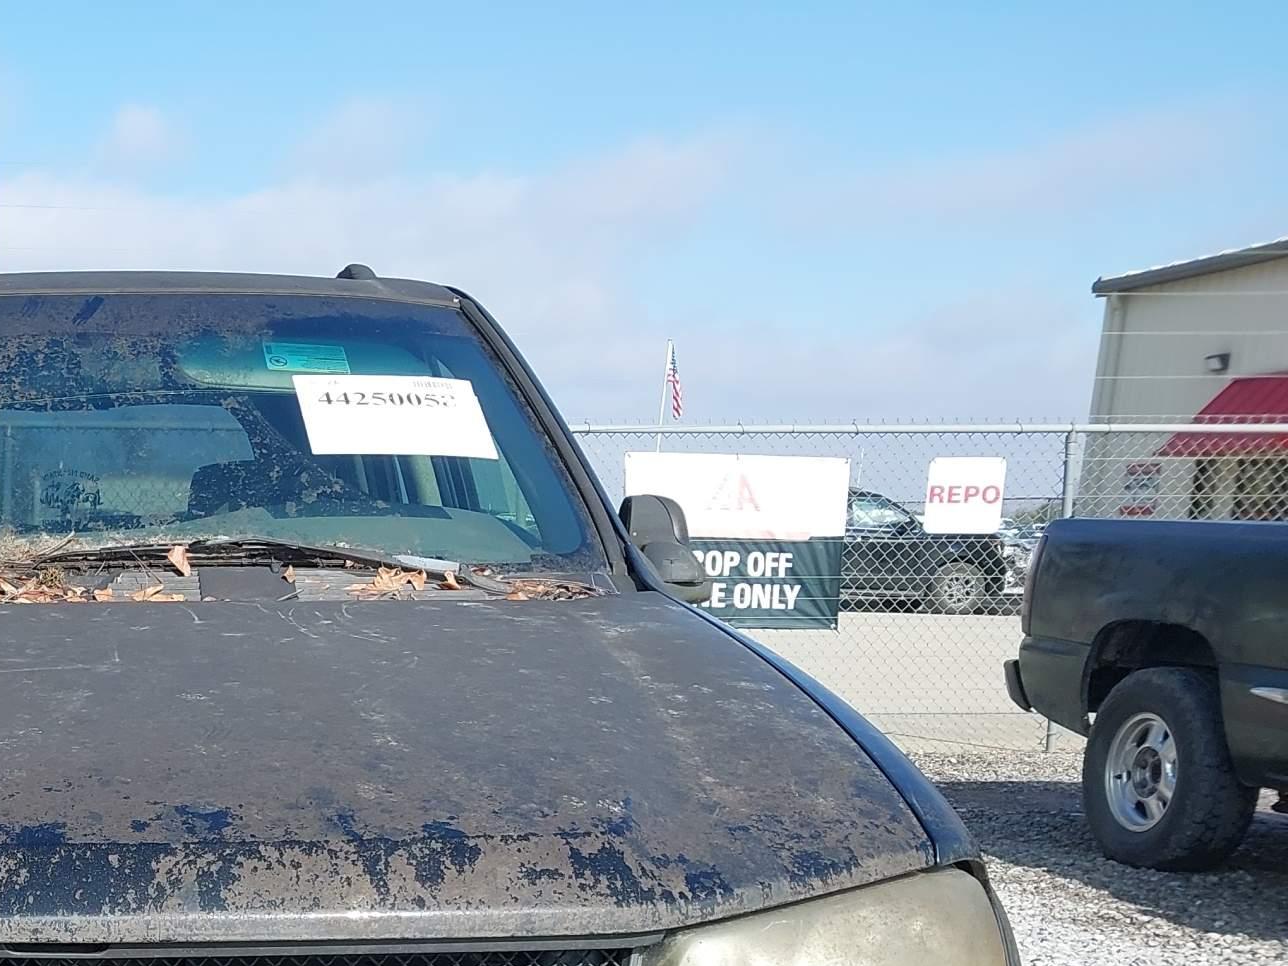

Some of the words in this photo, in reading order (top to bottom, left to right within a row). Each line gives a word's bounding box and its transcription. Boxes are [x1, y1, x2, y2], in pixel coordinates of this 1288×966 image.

[929, 485, 1001, 504] REPO
[747, 551, 793, 578] OFF
[733, 582, 802, 610] ONLY
